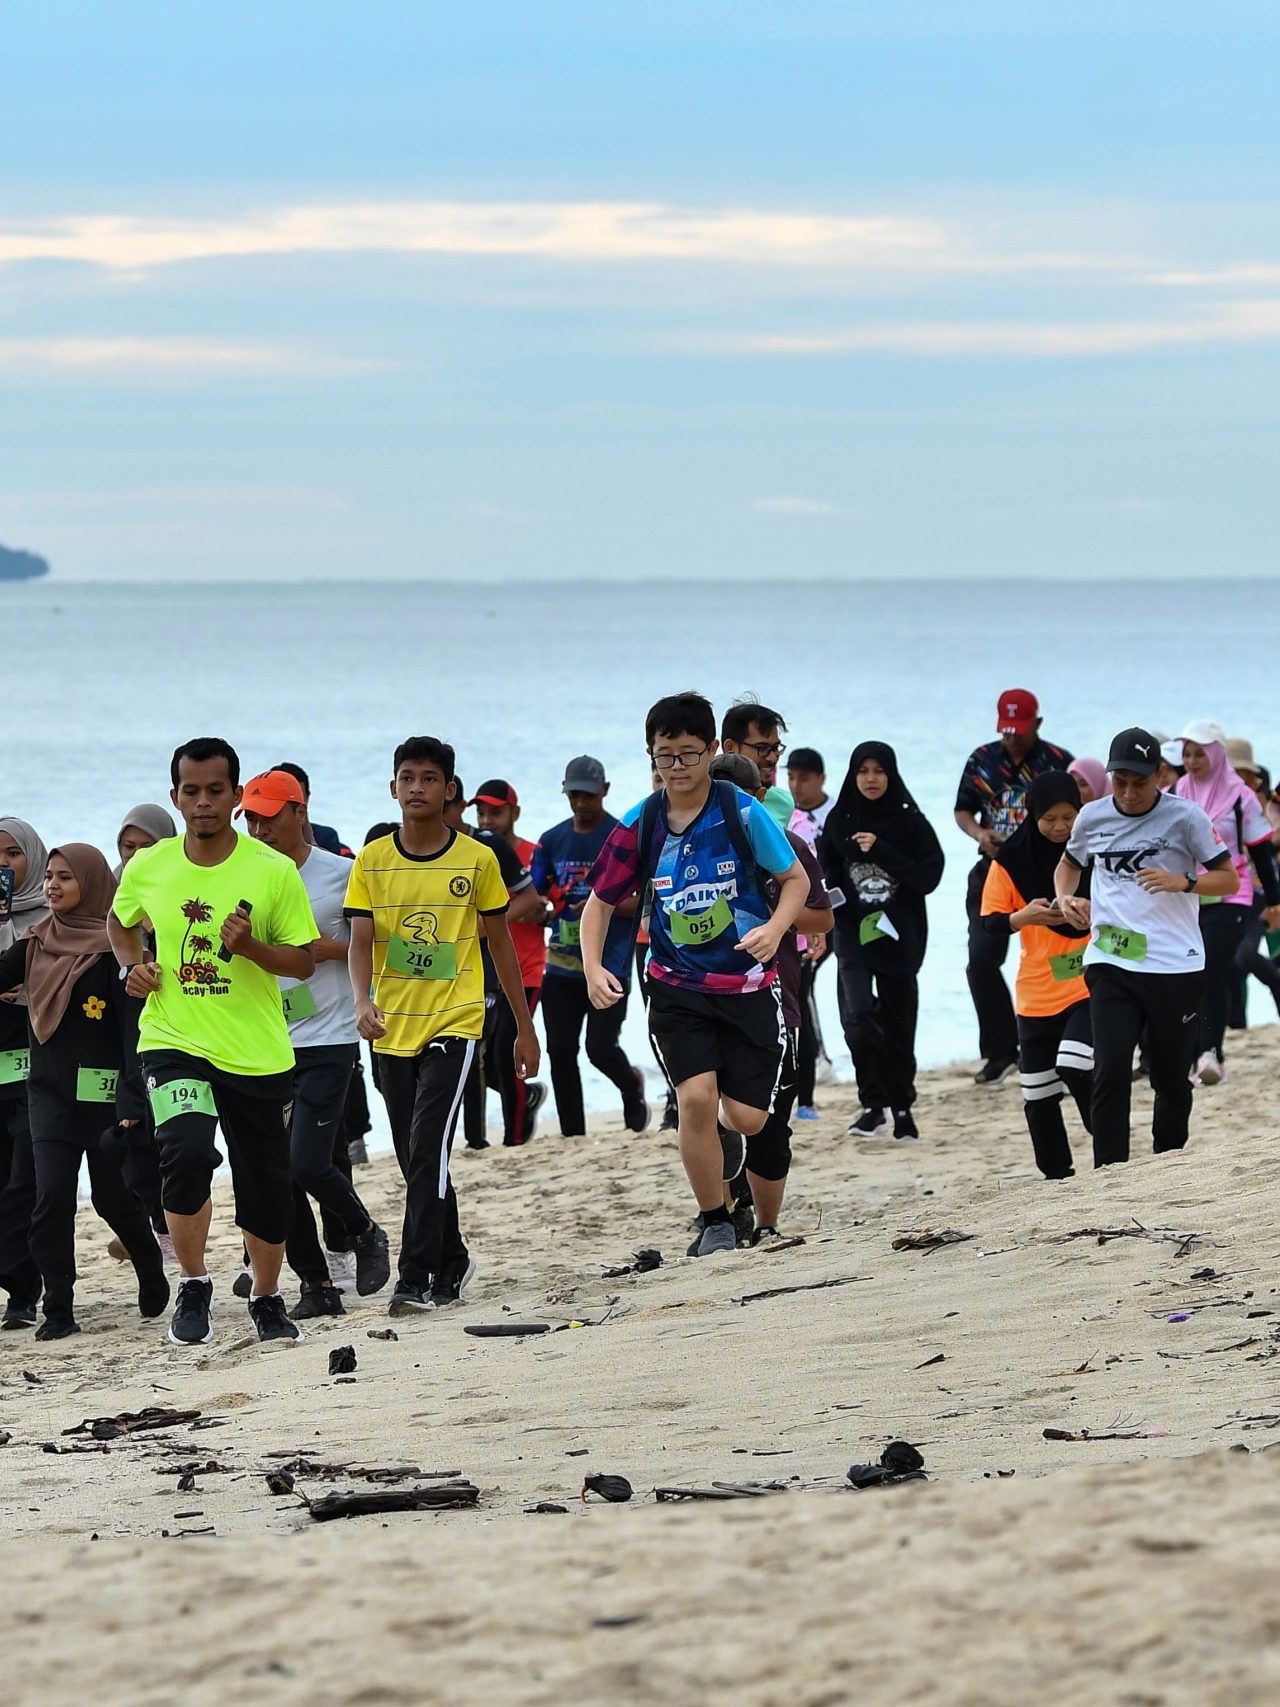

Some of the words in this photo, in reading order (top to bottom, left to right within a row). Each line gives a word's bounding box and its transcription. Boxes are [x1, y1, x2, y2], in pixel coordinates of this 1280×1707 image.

[689, 915, 716, 935] 051
[406, 951, 433, 967] 216
[170, 1087, 199, 1104] 194
